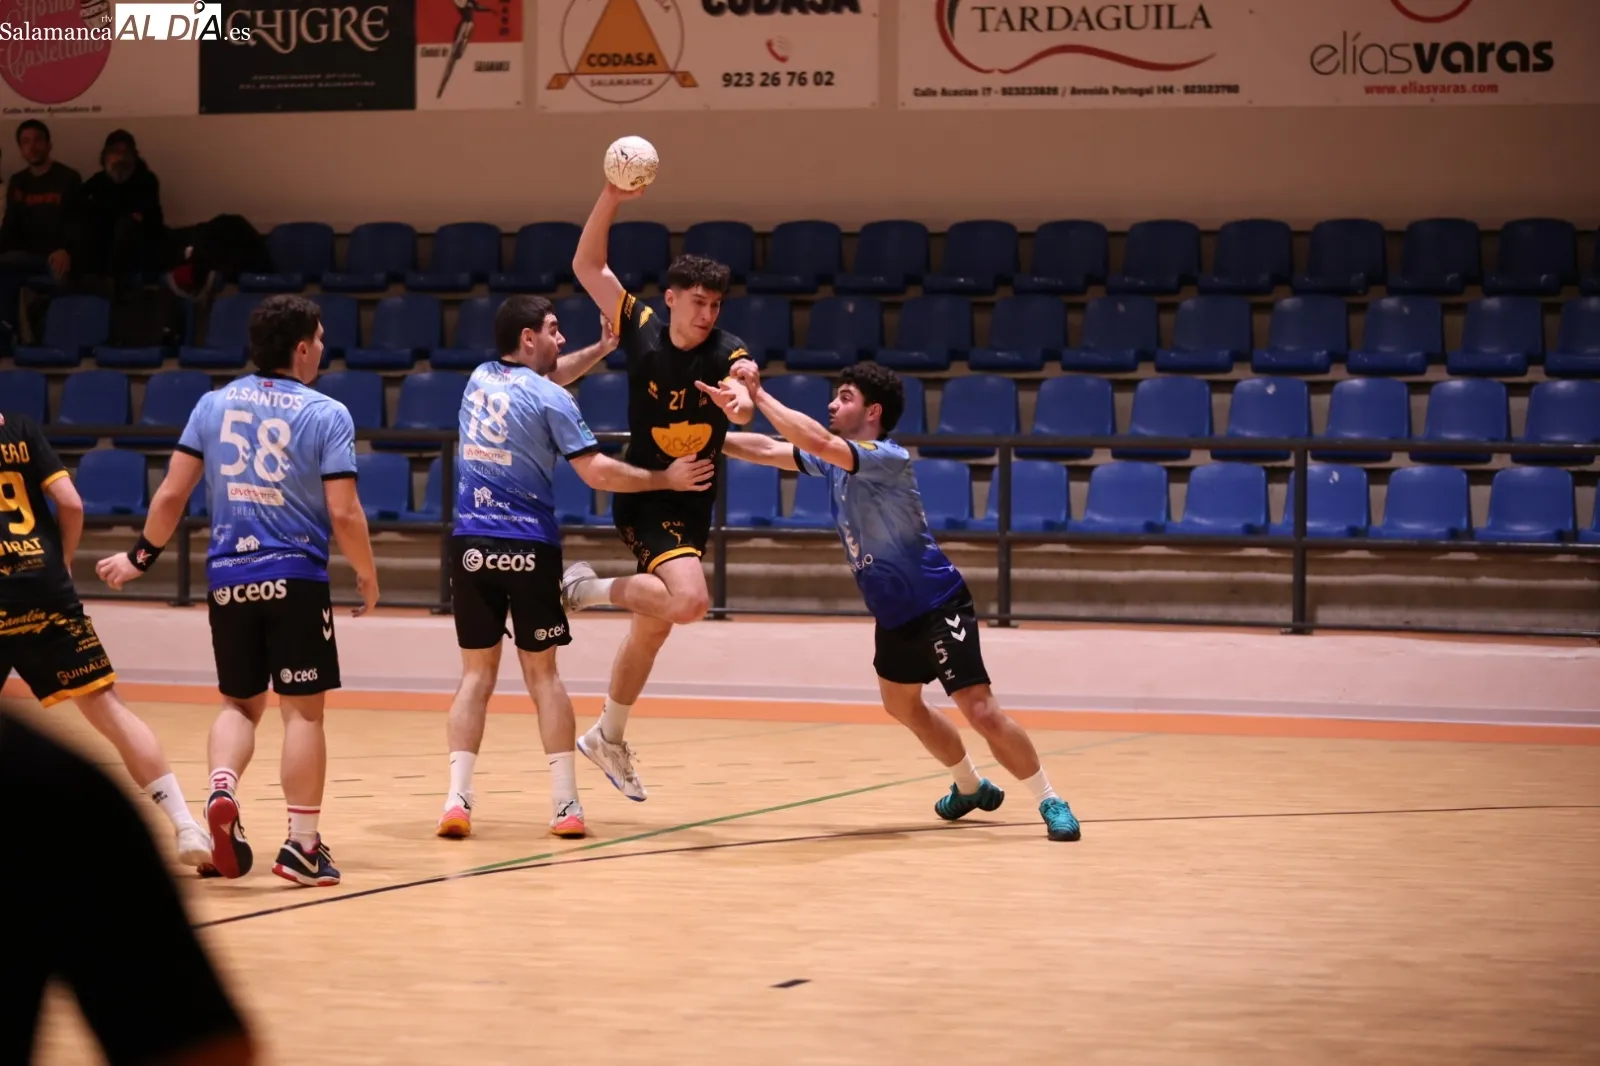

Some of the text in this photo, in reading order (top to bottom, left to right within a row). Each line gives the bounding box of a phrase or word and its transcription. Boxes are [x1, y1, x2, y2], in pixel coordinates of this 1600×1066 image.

[971, 4, 1213, 33] TARDAGUILA
[586, 52, 658, 67] CODASA
[589, 77, 654, 87] SALAMANCA
[722, 71, 835, 87] 923 26 76 02
[1363, 81, 1499, 96] www.eliasvaras.com
[226, 386, 304, 410] D.SANTOS
[468, 388, 510, 444] 18
[220, 409, 291, 482] 58
[485, 553, 536, 571] ceos
[233, 579, 287, 603] ceos
[934, 640, 948, 664] 5
[294, 668, 318, 682] ceos
